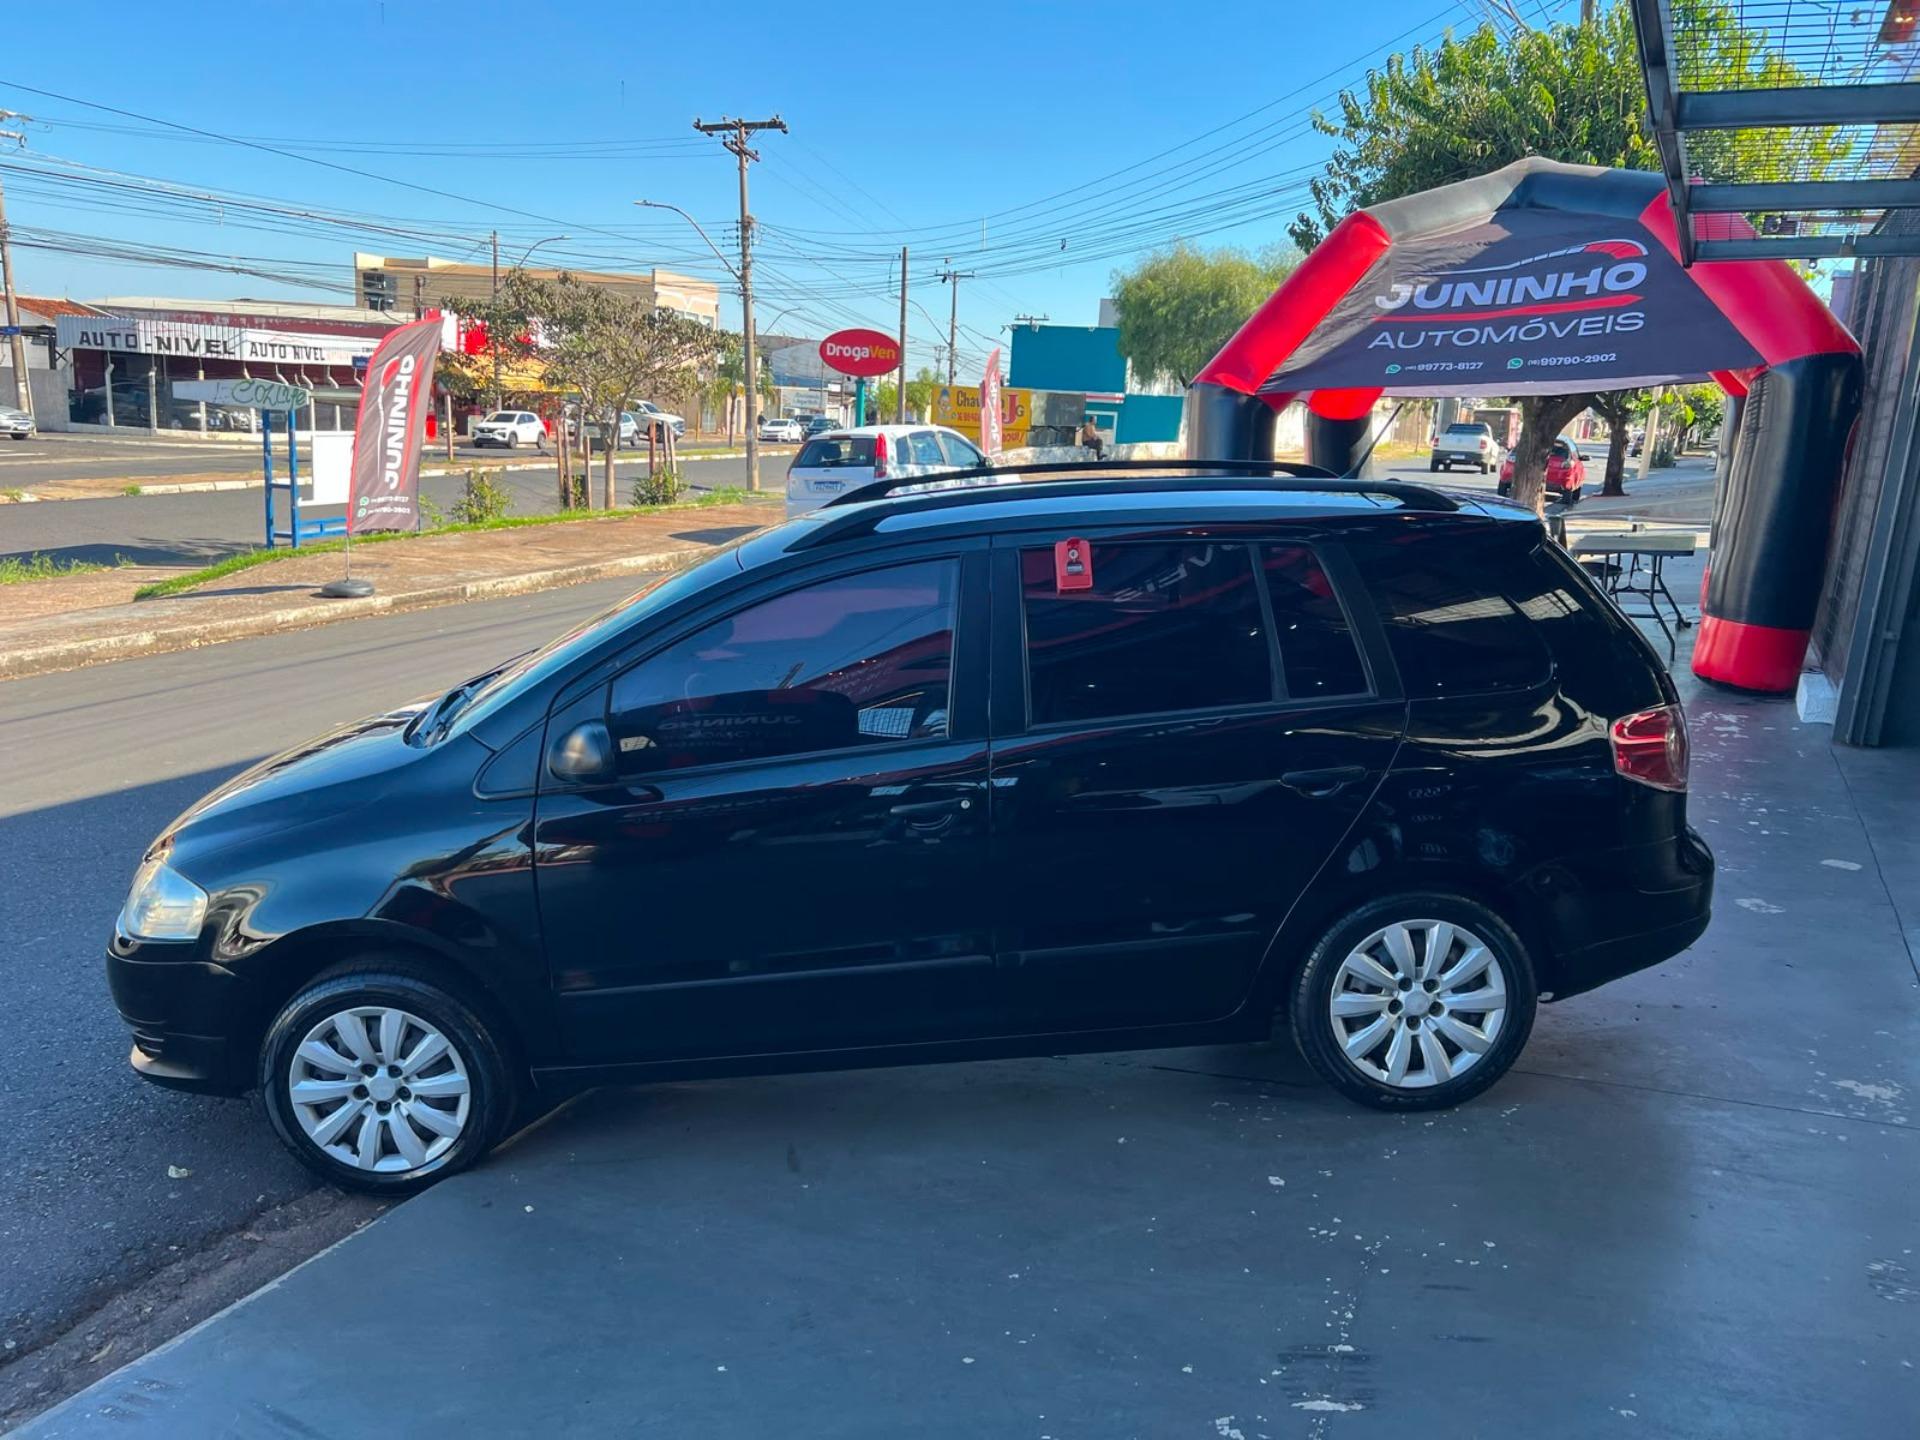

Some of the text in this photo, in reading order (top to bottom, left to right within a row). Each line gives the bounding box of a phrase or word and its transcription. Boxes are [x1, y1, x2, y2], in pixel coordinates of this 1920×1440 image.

[1375, 263, 1648, 309] JUNINHO
[79, 330, 138, 348] AUTO
[155, 335, 236, 355] NIVEL
[1368, 312, 1646, 350] AUTOMÓVEIS
[250, 341, 287, 359] AUTO
[293, 344, 326, 361] NIVEL
[826, 343, 896, 361] DrogaVen
[384, 354, 415, 490] JUNINHO
